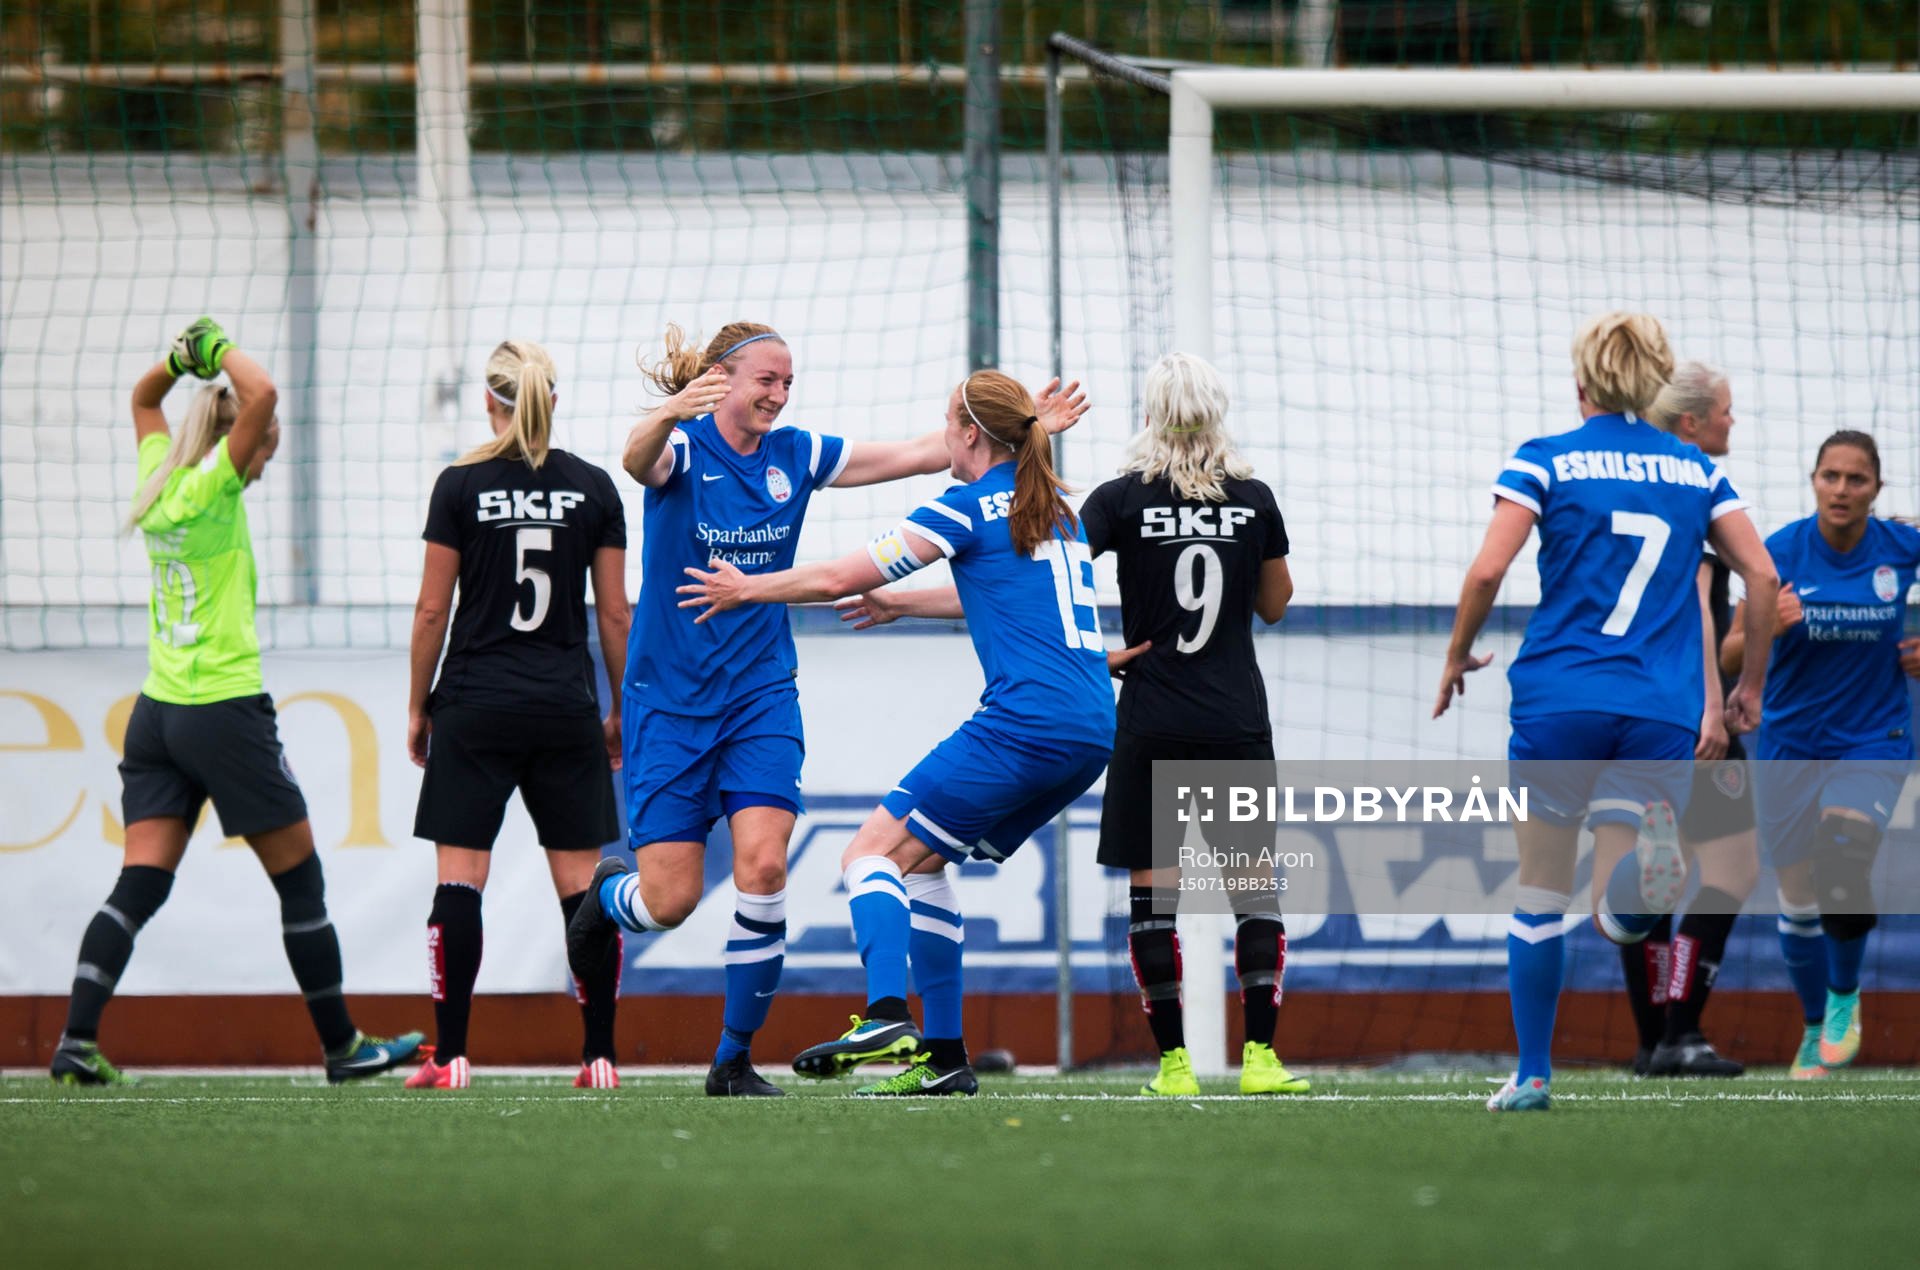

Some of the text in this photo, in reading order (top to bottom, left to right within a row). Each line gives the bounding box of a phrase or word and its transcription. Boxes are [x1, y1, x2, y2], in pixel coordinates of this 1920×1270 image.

[477, 489, 586, 522] SKF
[1140, 506, 1256, 538] SKF
[695, 522, 790, 547] Sparbanken
[509, 528, 553, 632] 5
[1601, 509, 1671, 637] 7
[1174, 543, 1224, 654] 9
[1802, 605, 1897, 625] parbanken
